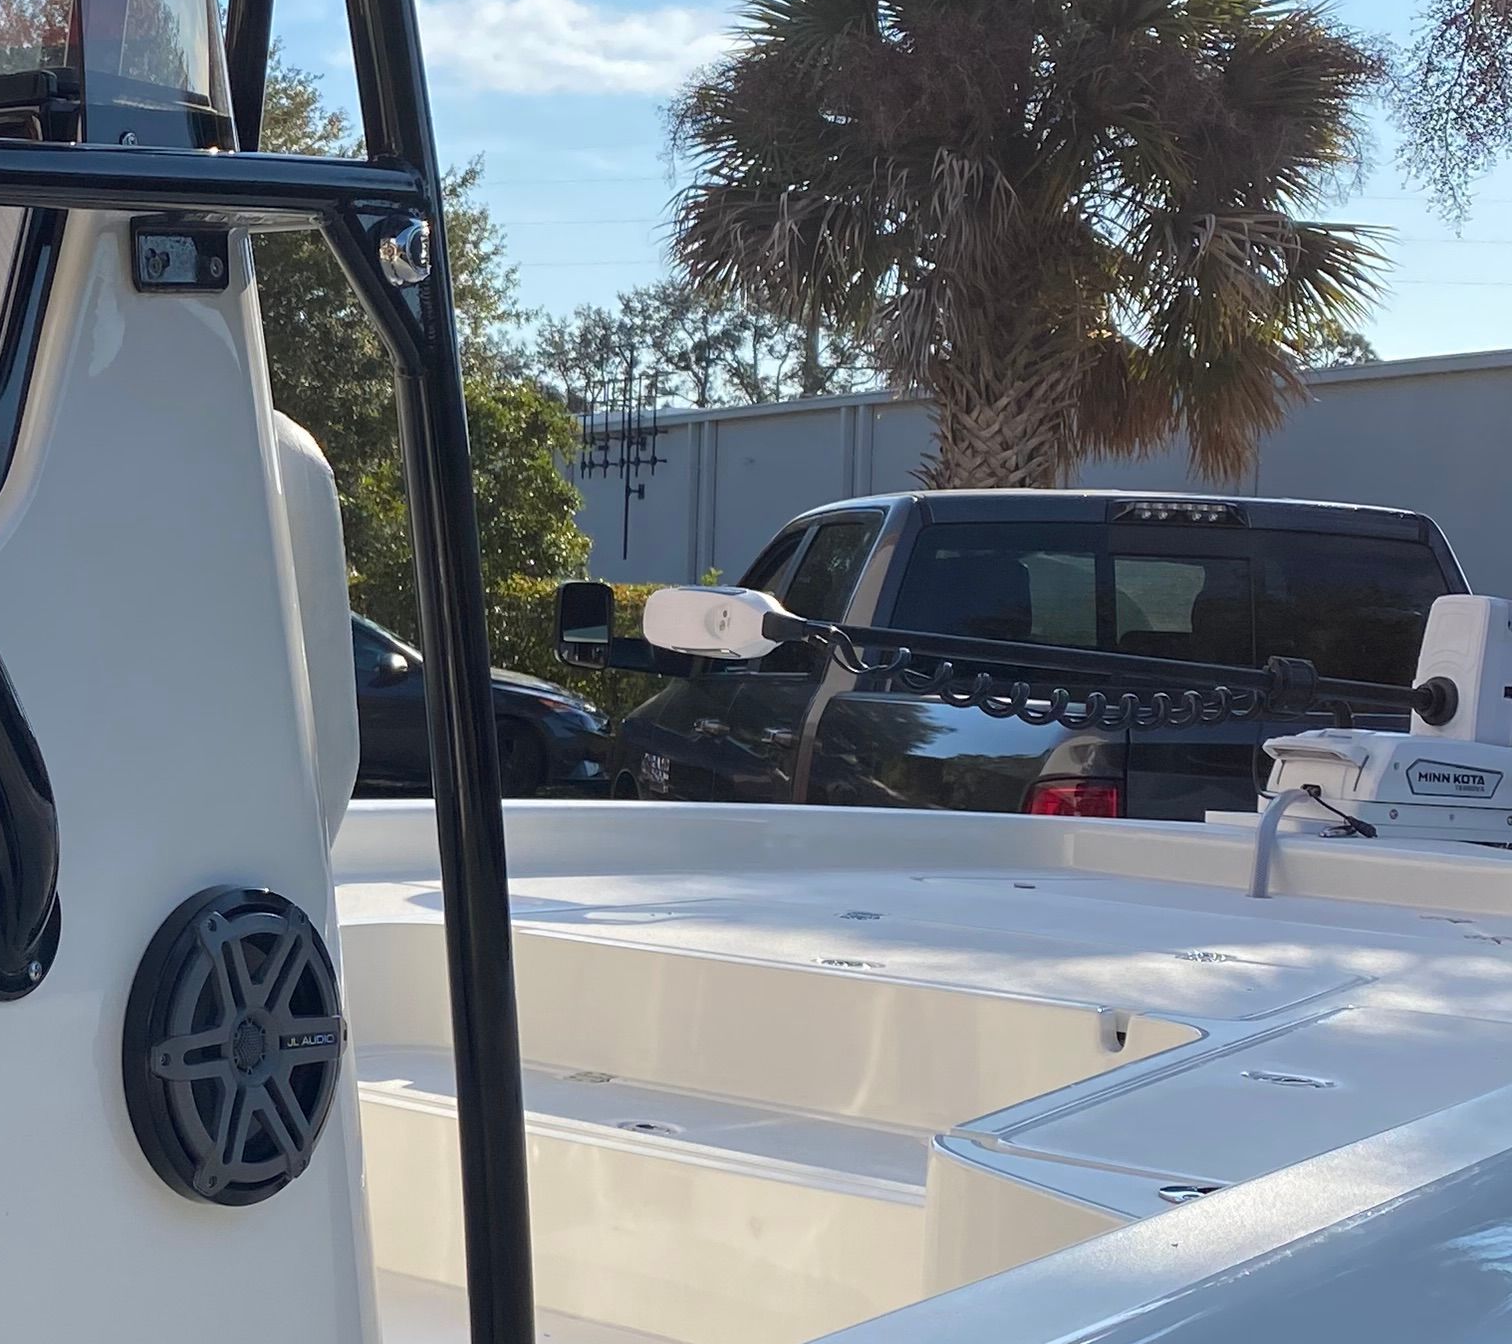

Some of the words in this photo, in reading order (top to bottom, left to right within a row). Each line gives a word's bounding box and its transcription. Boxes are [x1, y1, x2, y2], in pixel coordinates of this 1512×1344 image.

[1418, 771, 1450, 783] MINN
[1453, 774, 1485, 785] KOTA
[287, 1037, 299, 1047] JL
[301, 1034, 335, 1046] AUDIO
